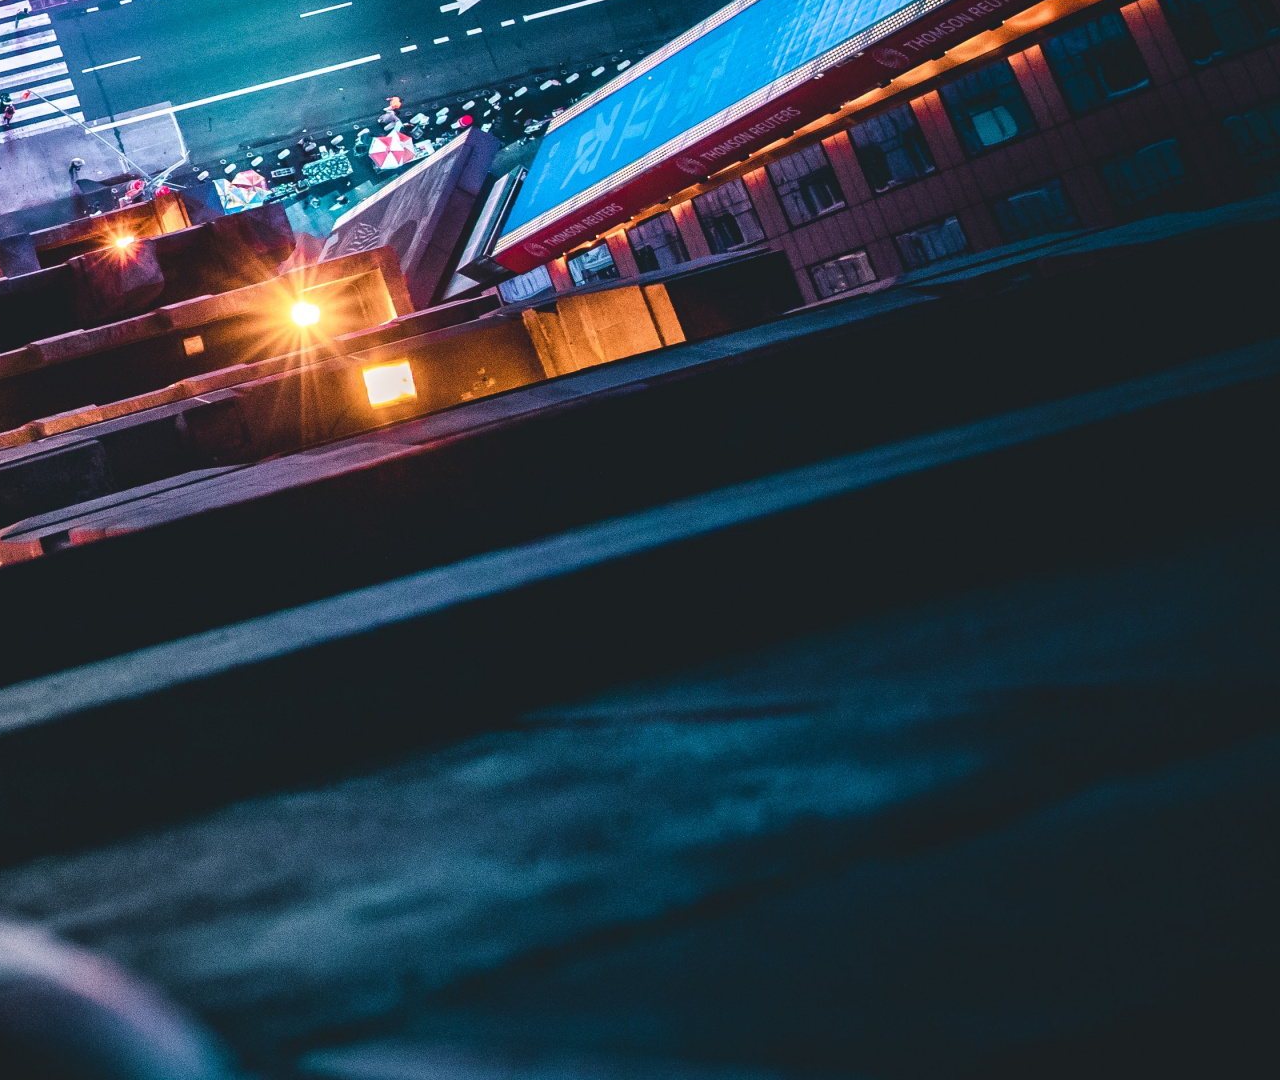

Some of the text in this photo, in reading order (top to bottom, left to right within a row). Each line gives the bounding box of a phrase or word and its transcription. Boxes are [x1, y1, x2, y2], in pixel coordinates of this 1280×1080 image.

[903, 14, 973, 52] THOMSON
[700, 106, 801, 163] THOMSON REUTERS
[544, 203, 624, 247] THOMSON REUTERS
